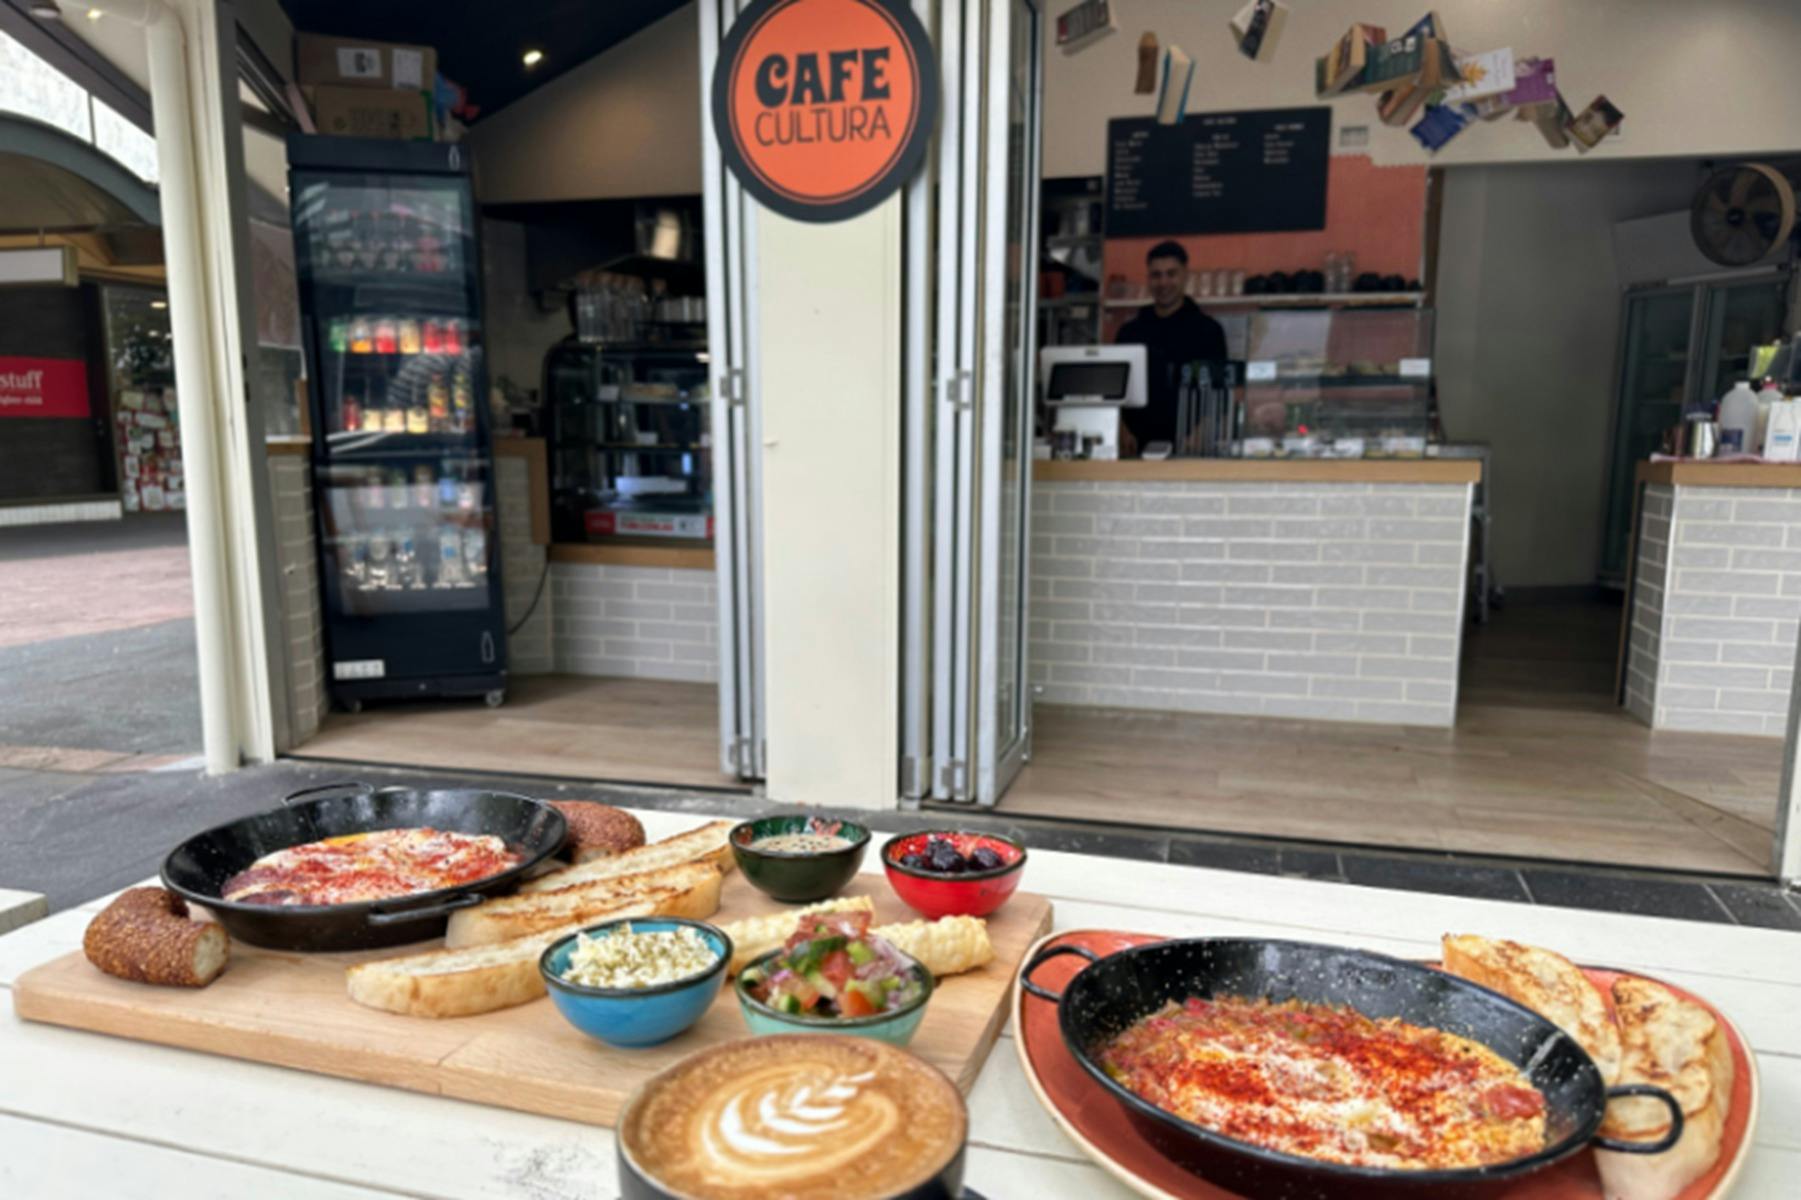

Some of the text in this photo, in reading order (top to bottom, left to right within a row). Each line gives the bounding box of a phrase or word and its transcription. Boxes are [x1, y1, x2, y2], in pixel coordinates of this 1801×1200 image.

[754, 46, 891, 109] CAFE
[754, 105, 892, 147] CULTURA
[0, 369, 43, 389] stuff
